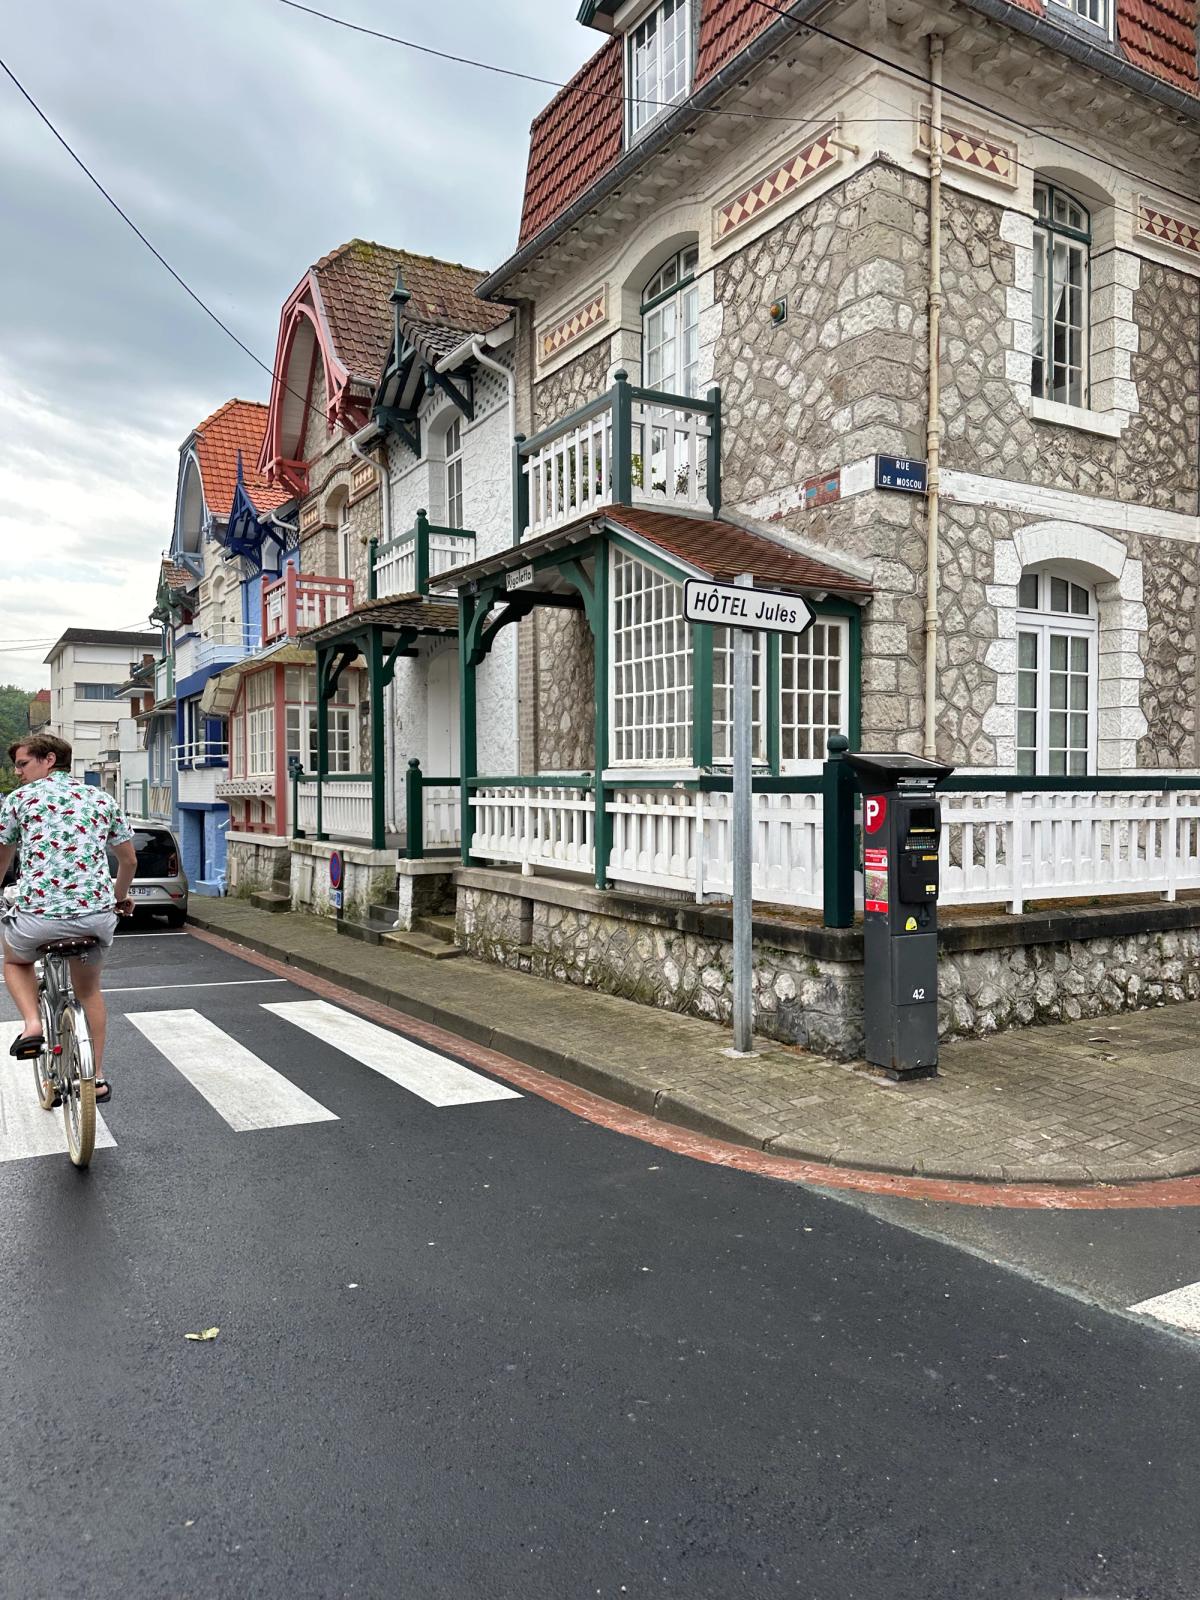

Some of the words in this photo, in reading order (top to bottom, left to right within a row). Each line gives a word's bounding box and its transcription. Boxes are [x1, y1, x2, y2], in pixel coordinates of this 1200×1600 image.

[895, 460, 910, 471] RUE
[882, 475, 891, 484] DE
[896, 477, 922, 489] MOSCOU
[506, 569, 532, 588] Rigoletto
[694, 588, 748, 617] HÔTEL
[755, 601, 797, 623] Jules
[866, 800, 879, 826] P
[912, 988, 925, 1000] 42
